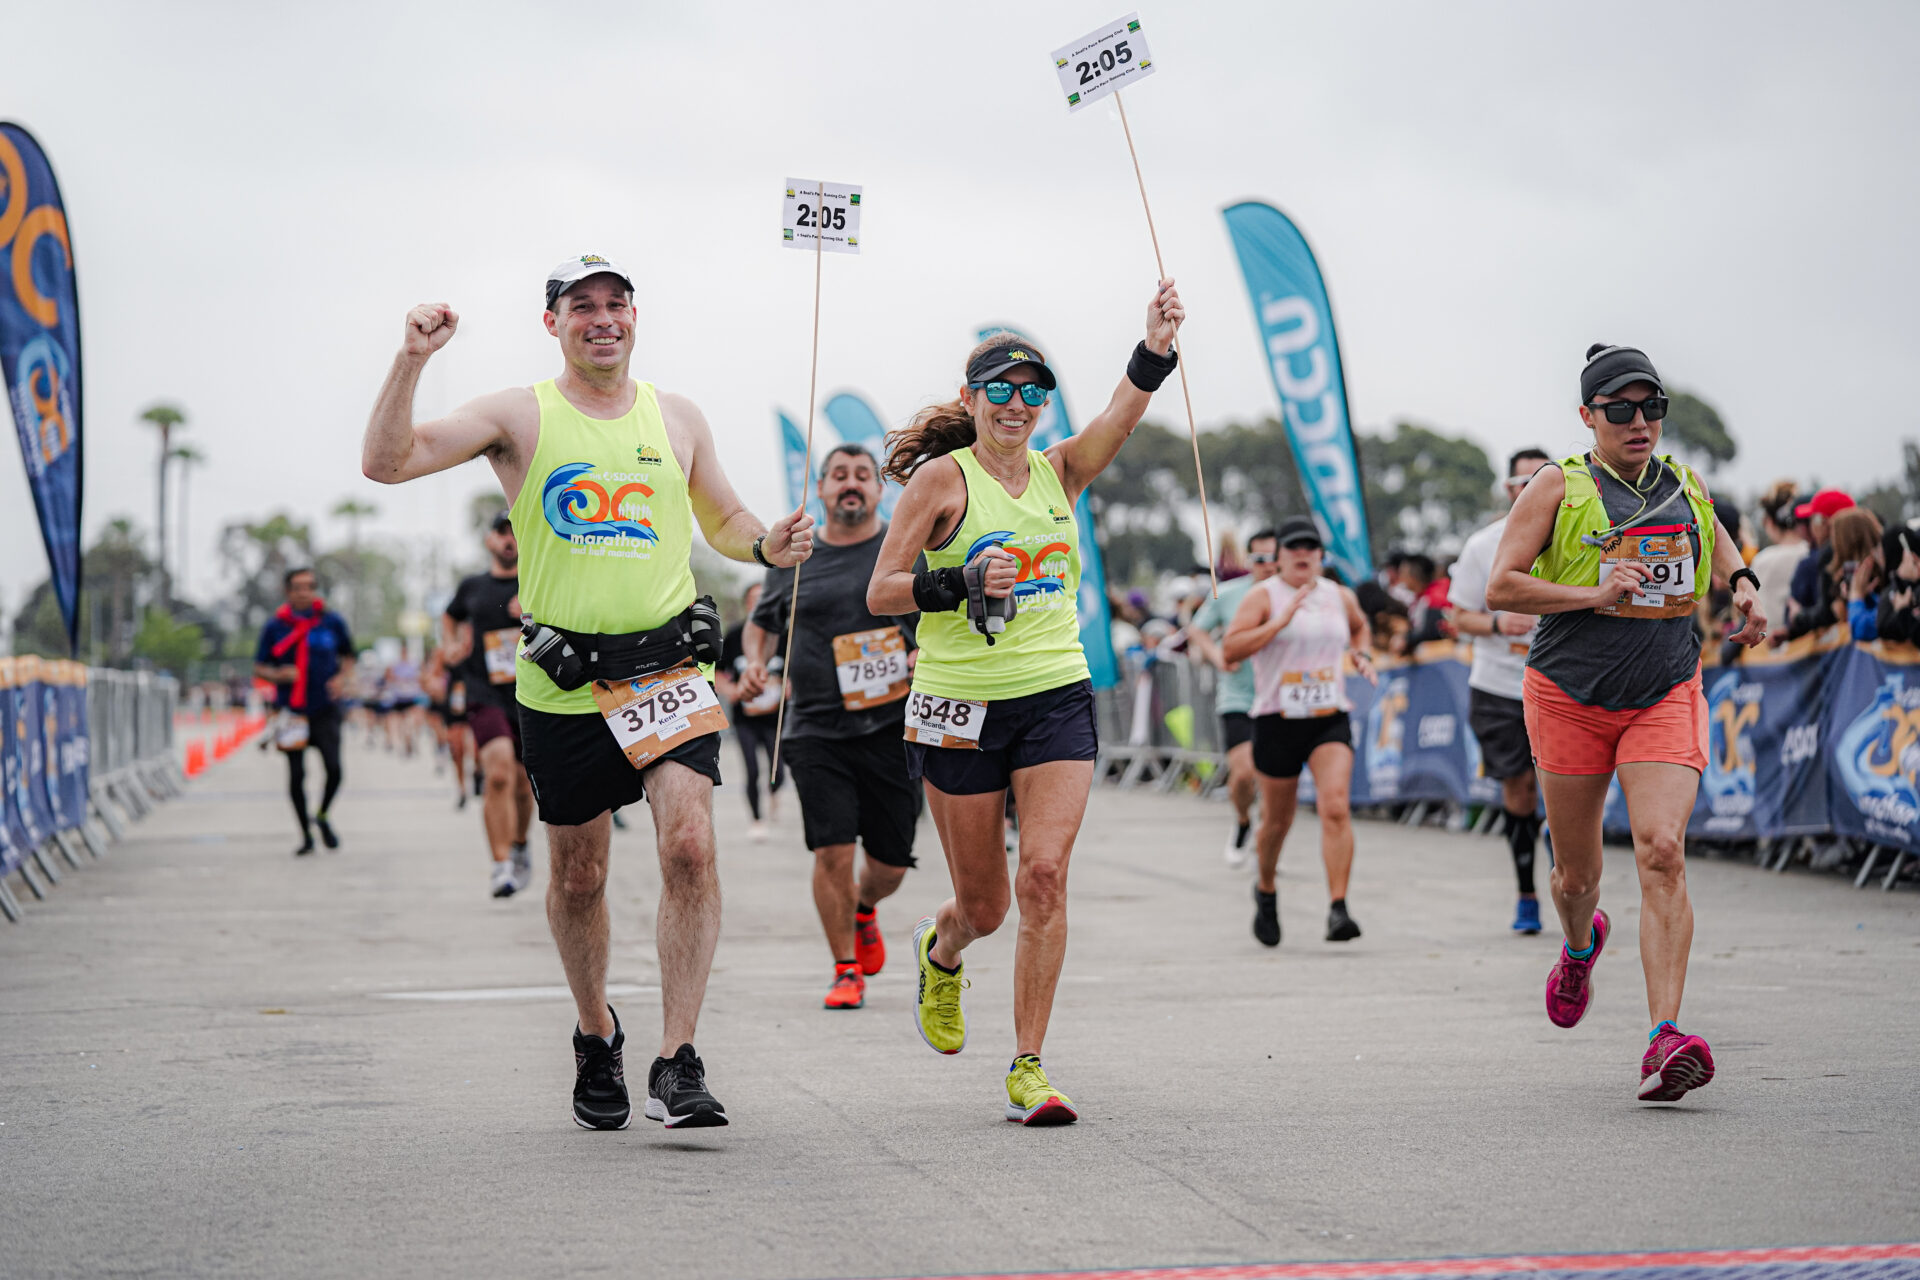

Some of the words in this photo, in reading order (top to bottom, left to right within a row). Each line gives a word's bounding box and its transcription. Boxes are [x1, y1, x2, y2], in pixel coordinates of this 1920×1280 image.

[1076, 40, 1133, 86] 2:05
[797, 204, 846, 230] 2:05
[614, 473, 649, 482] SDCCU
[571, 531, 651, 549] marathon
[1035, 532, 1066, 544] SDCCU
[571, 547, 586, 555] and
[589, 546, 605, 556] half
[608, 549, 650, 560] marathon
[849, 657, 899, 682] 7895
[621, 699, 641, 709] SDCCU
[666, 673, 698, 687] MARATHON
[621, 682, 698, 733] 3785
[912, 693, 971, 727] 5548
[658, 713, 678, 725] Kent
[921, 720, 946, 731] Ricarda
